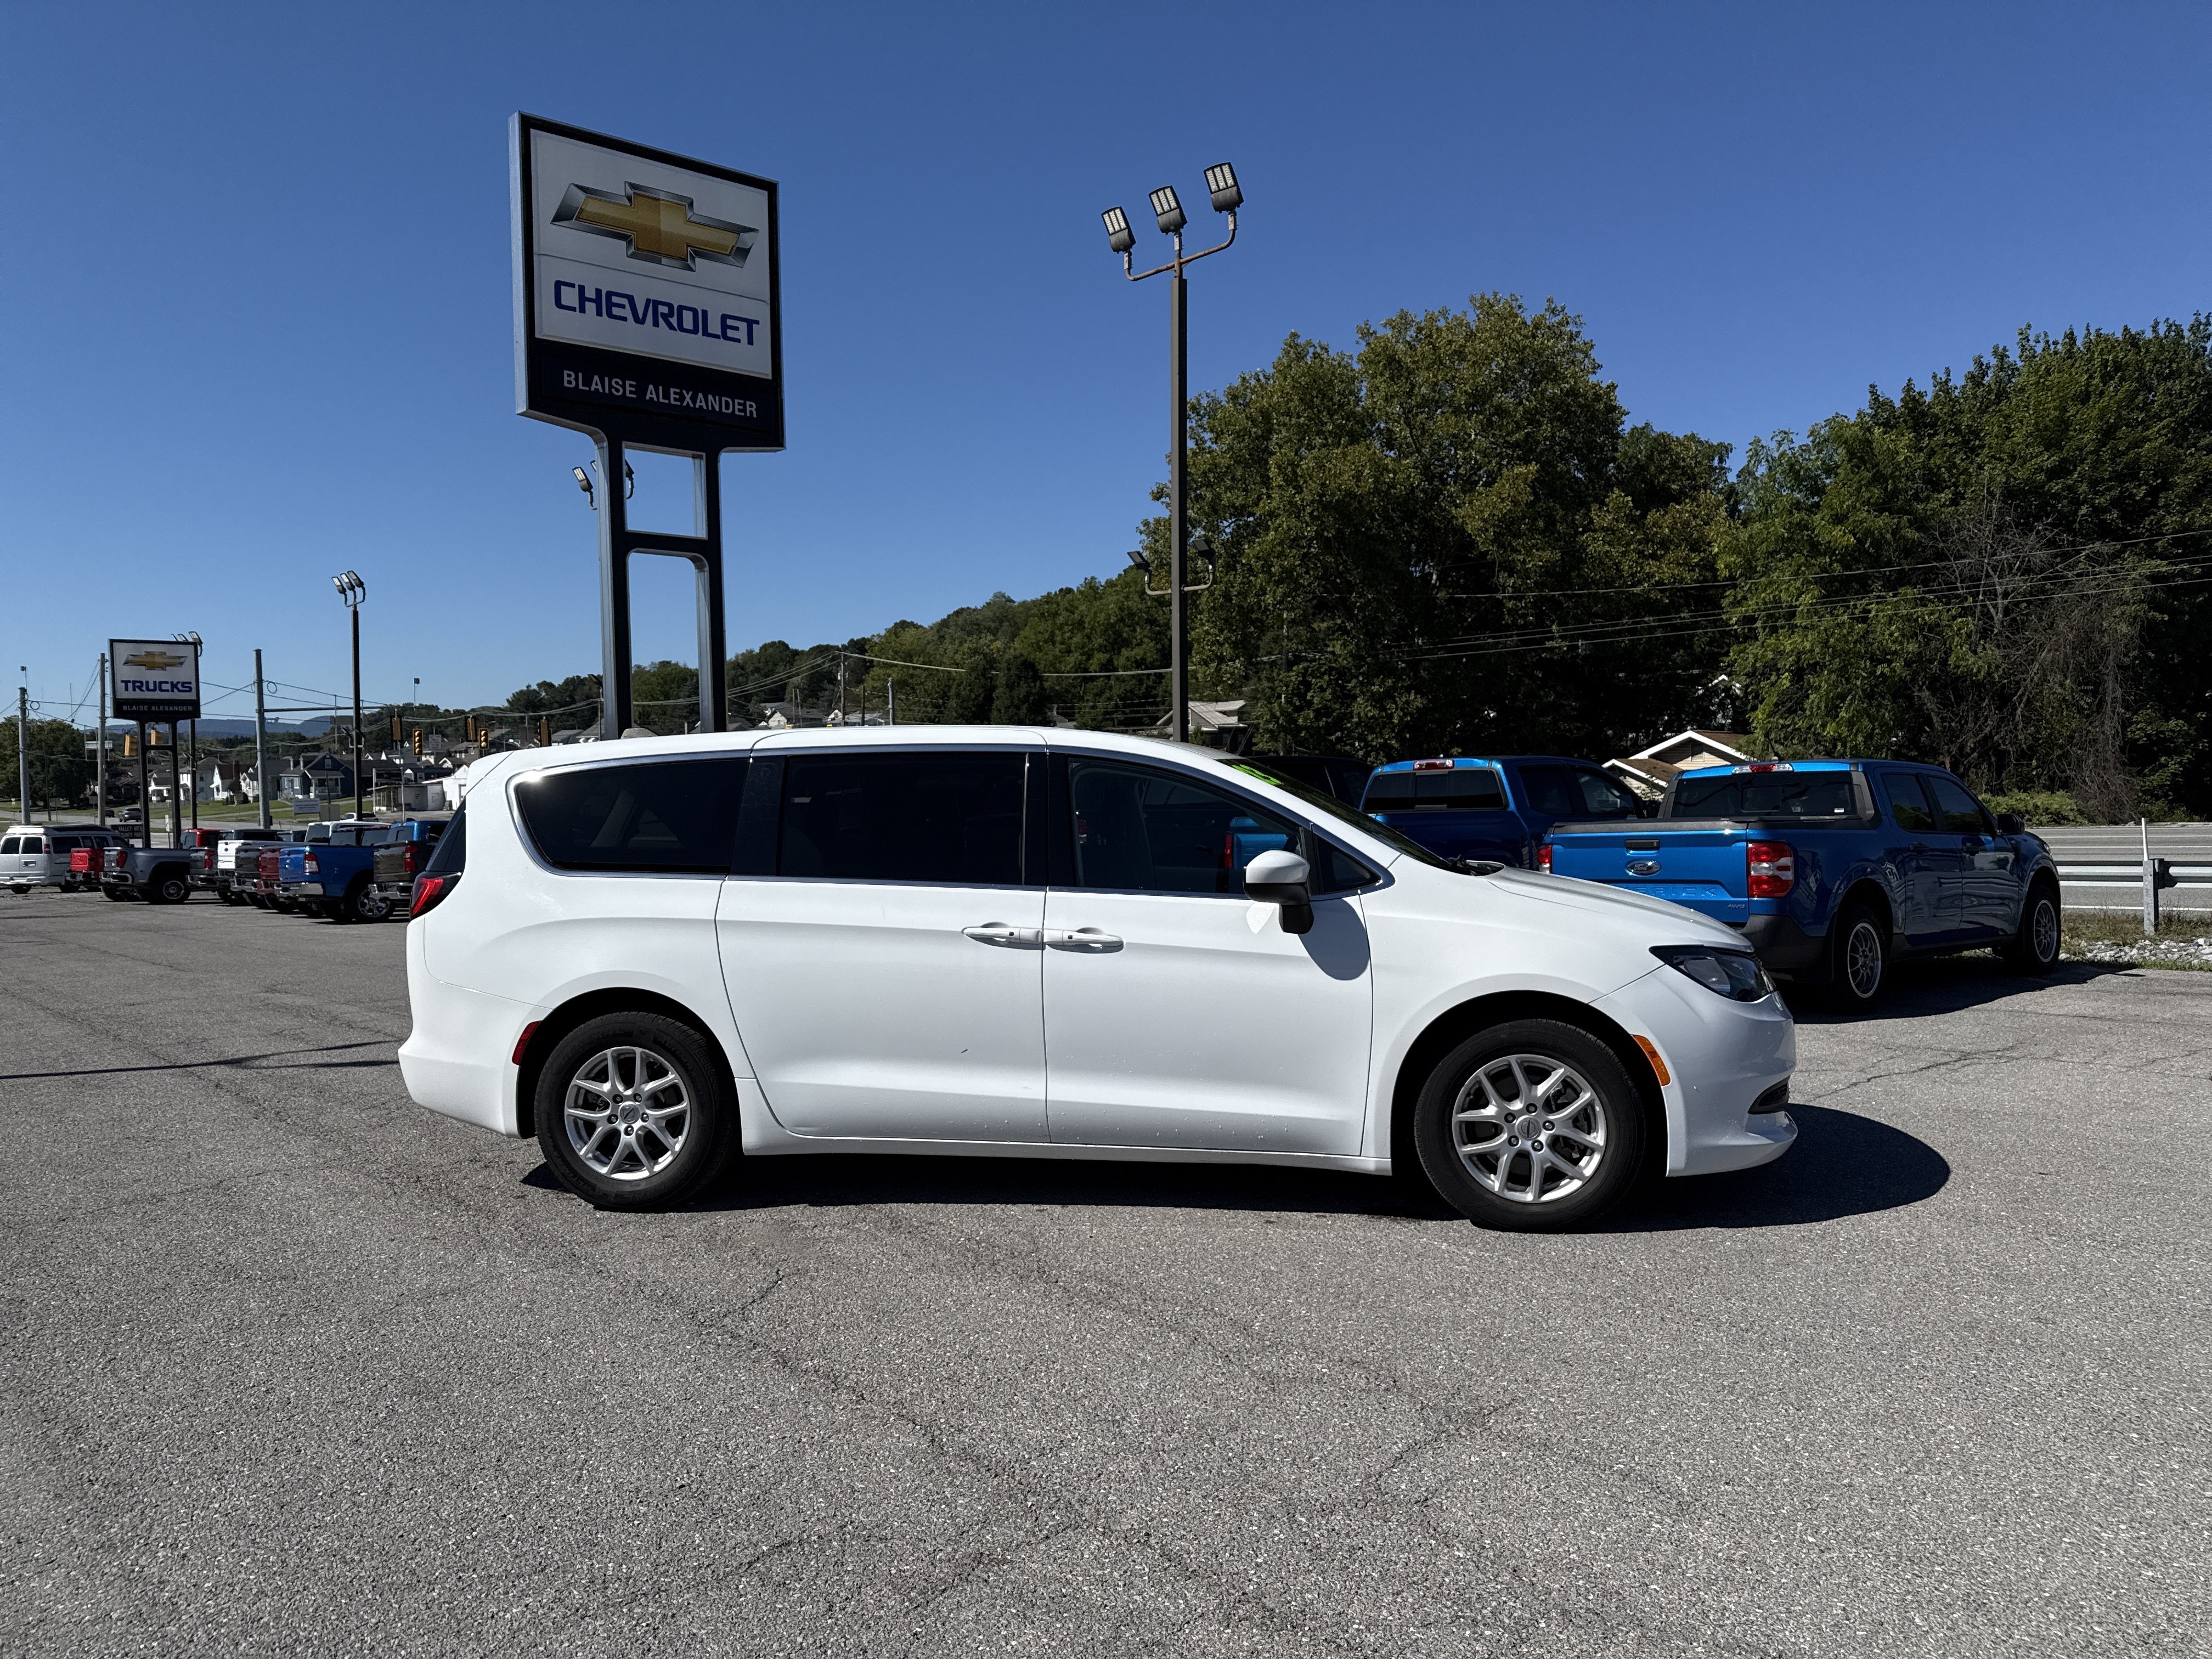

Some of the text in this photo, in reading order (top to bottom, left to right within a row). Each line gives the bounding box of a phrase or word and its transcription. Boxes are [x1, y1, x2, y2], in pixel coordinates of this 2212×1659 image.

[554, 280, 759, 346] CHEVROLET
[563, 370, 758, 418] BLAISE ALEXANDER
[121, 680, 192, 693] TRUCKS
[1633, 885, 1717, 896] ERICK
